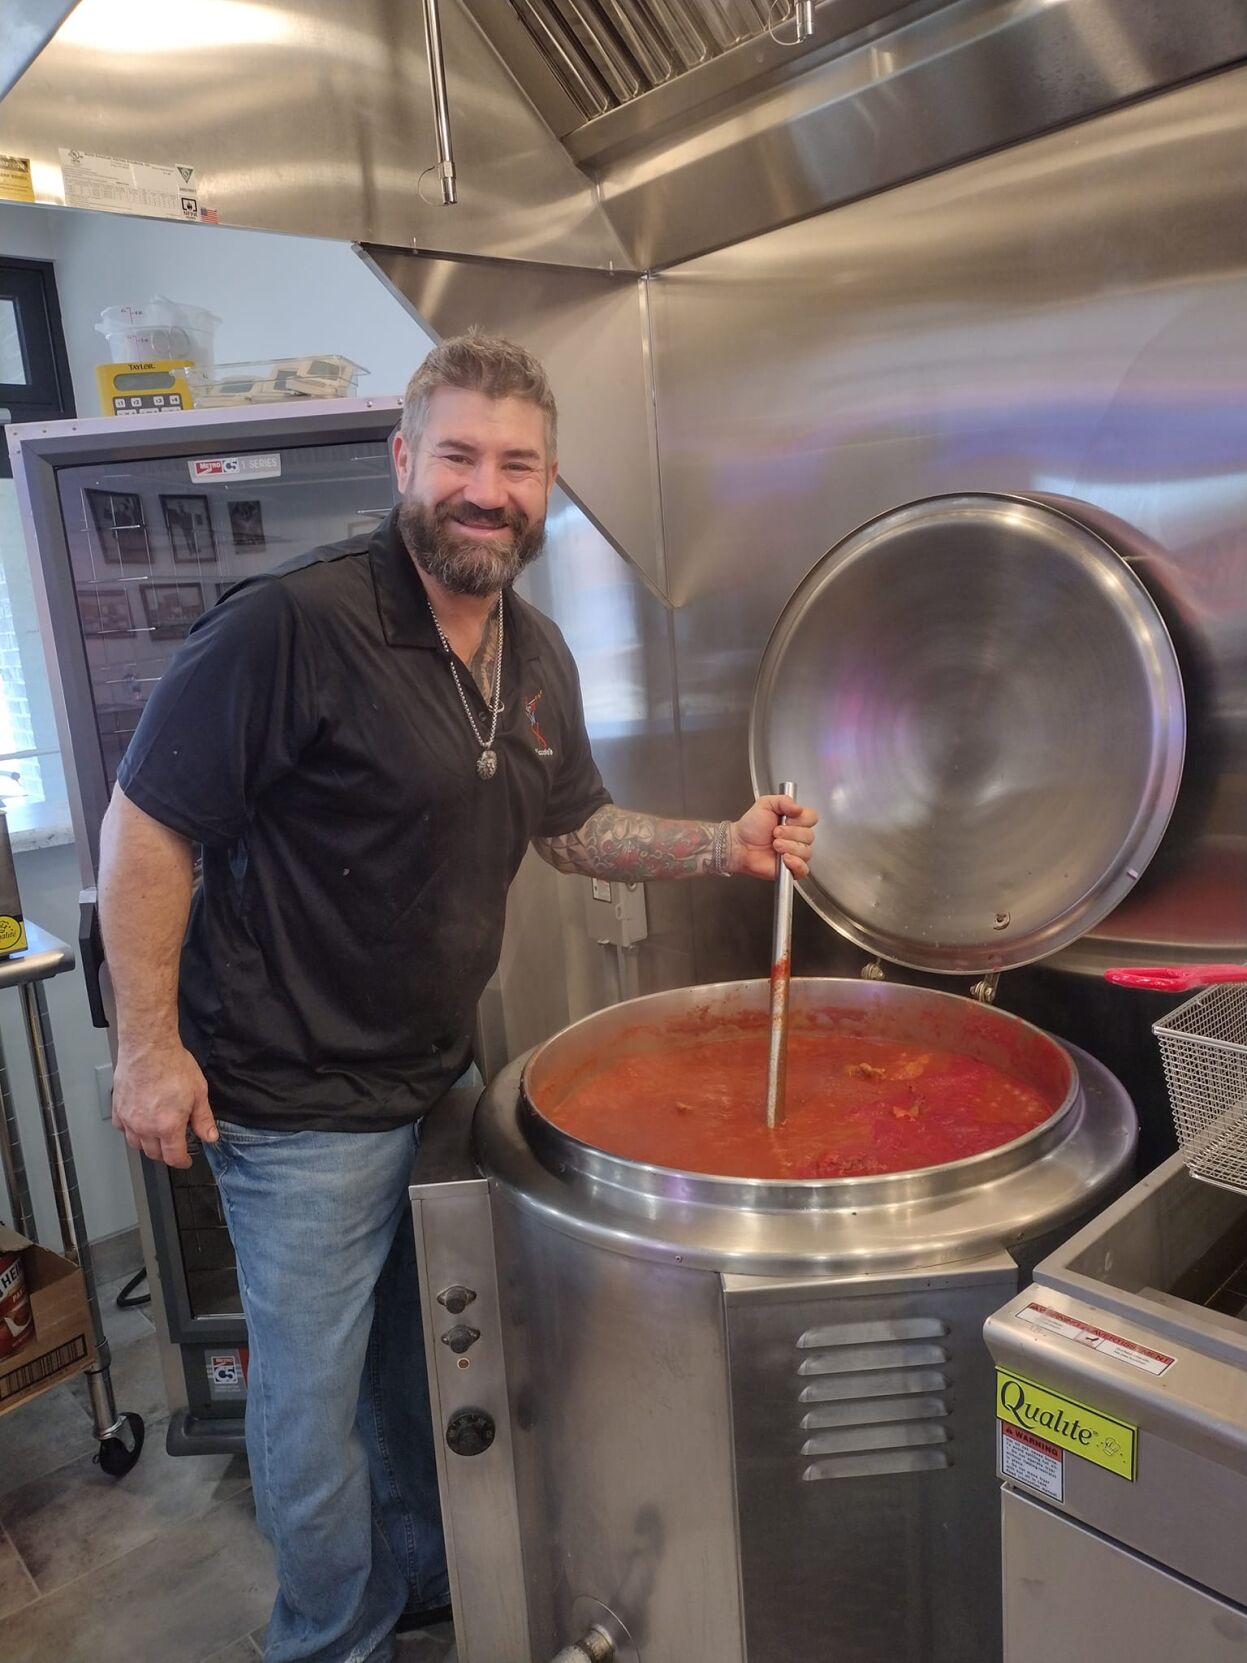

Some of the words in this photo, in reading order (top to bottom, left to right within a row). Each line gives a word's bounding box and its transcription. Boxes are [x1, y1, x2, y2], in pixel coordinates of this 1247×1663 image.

[128, 363, 154, 371] TAYLOR
[223, 459, 239, 473] C5
[249, 457, 277, 469] SERIES
[215, 1366, 235, 1382] C5
[1015, 1430, 1058, 1456] WARNING
